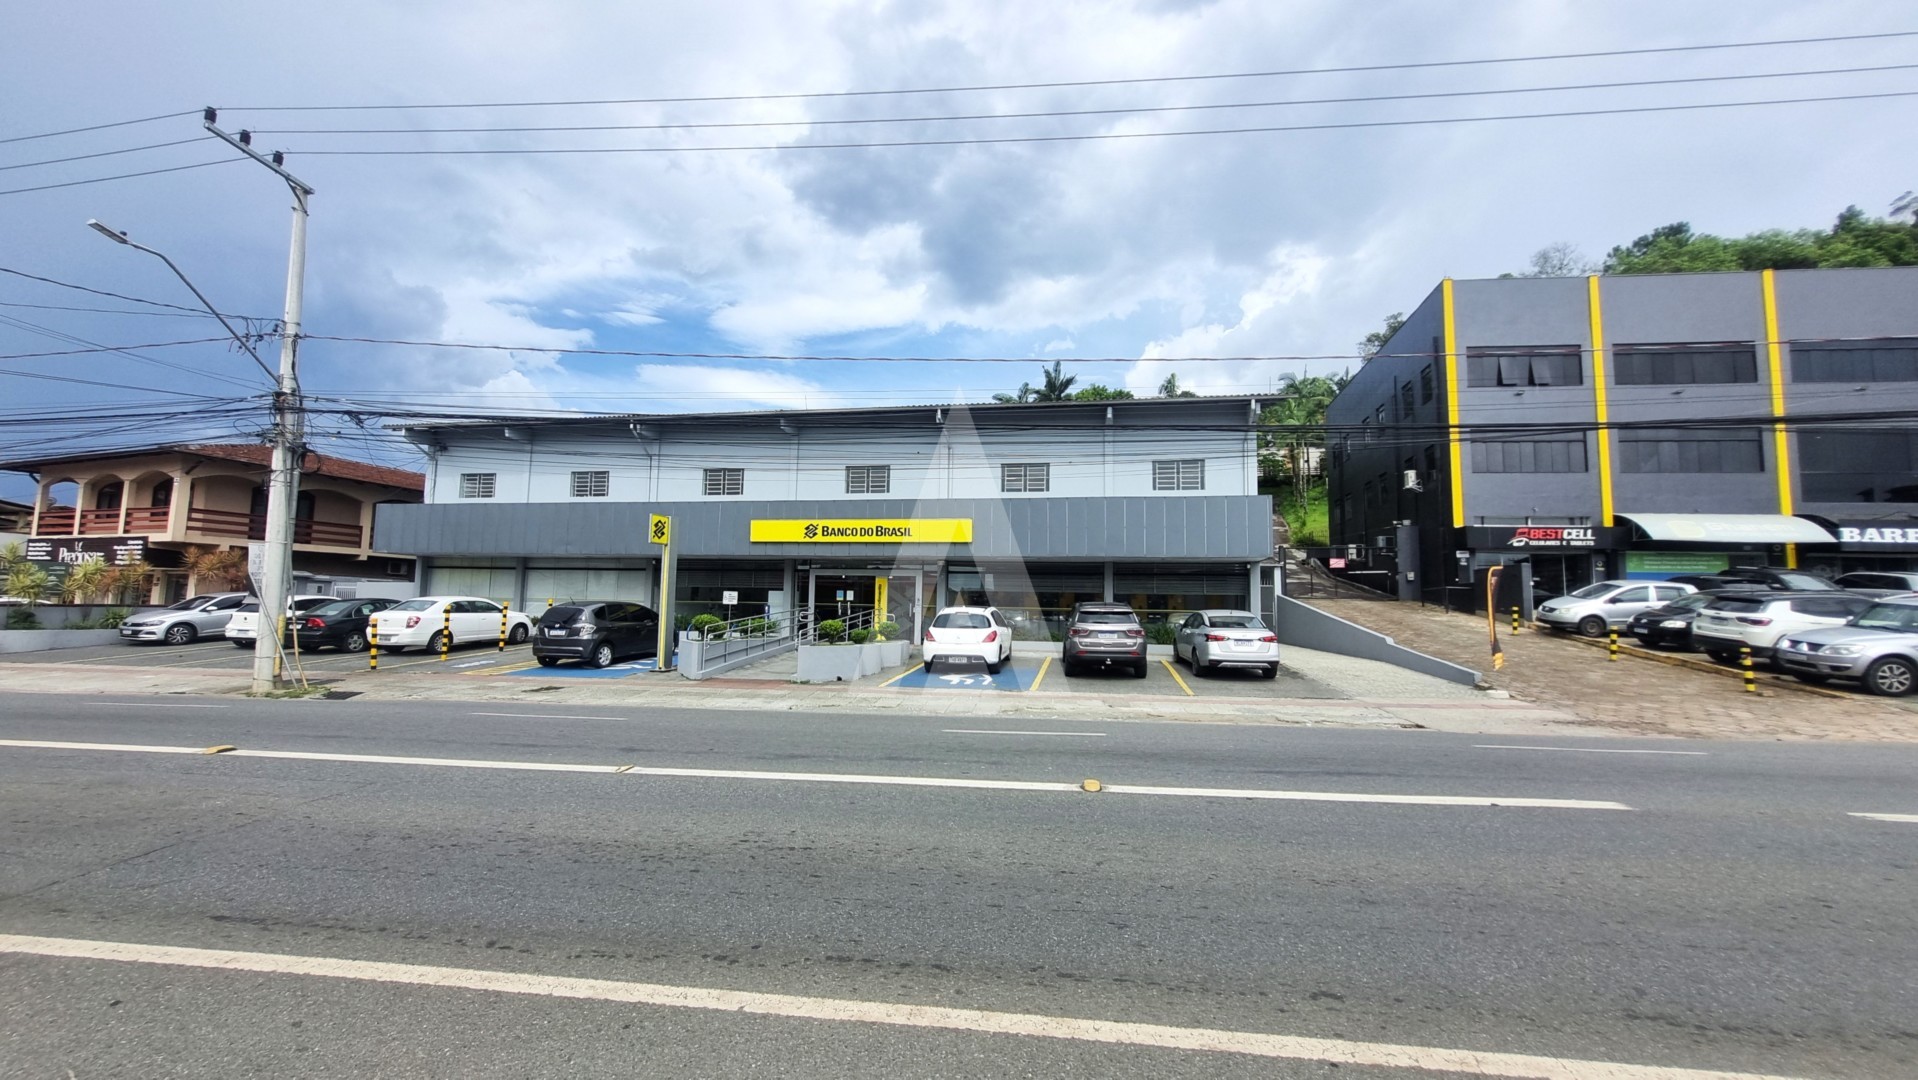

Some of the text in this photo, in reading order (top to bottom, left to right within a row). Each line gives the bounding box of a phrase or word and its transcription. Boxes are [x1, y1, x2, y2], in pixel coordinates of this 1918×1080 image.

[821, 525, 913, 537] BANCO DO BRASIL
